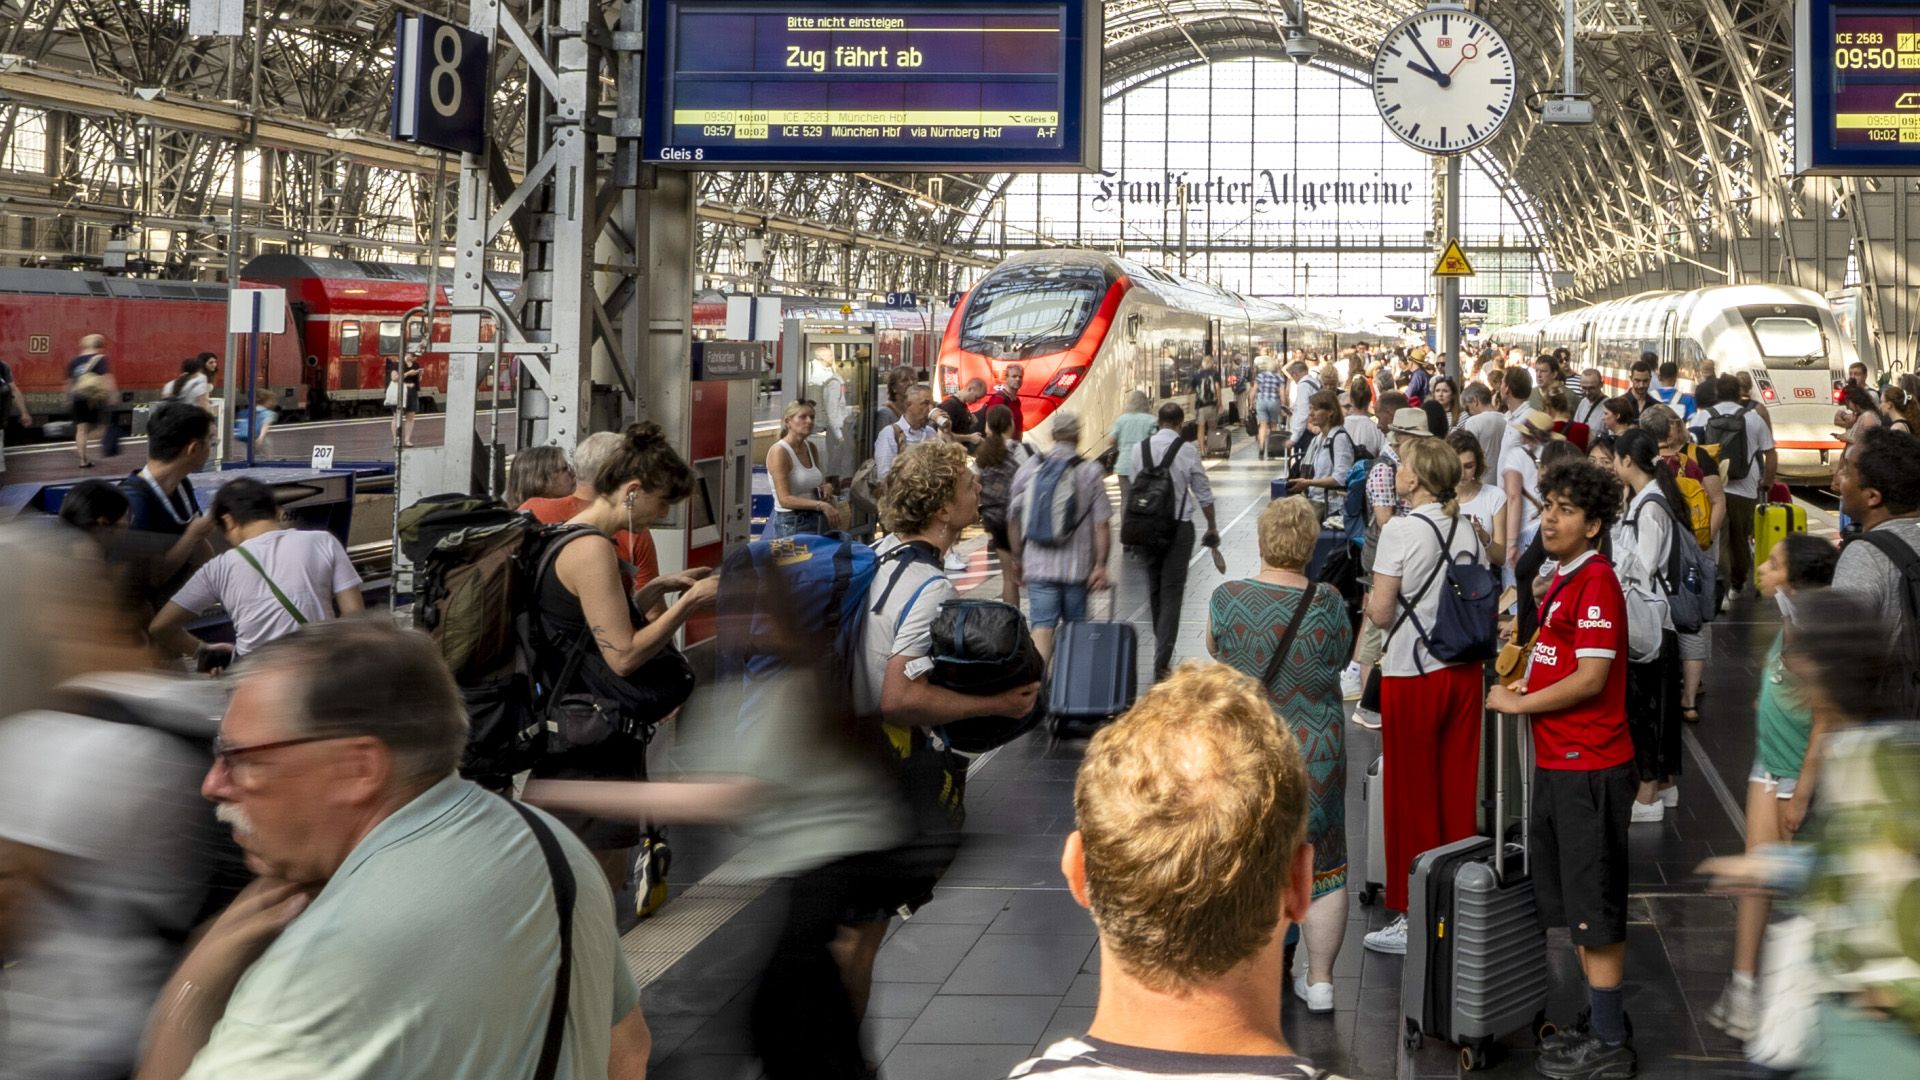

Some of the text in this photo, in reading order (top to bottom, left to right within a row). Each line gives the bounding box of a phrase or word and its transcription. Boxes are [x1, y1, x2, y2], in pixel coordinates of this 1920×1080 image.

[787, 16, 904, 29] Bitte nicht einsteigen
[1439, 39, 1450, 47] DB
[1836, 33, 1883, 44] ICE 2583
[786, 46, 923, 72] Zug fährt ab
[1835, 48, 1896, 69] 09:50
[430, 25, 462, 117] 8
[704, 112, 1056, 123] 09:50 10:00 ICE 2583 München Hbf Gleis 9
[1867, 115, 1897, 126] 09:50
[703, 126, 1056, 139] 09:57 10:02 ICE 529 München Hbf via Nürnberg Hbf A-F
[1867, 129, 1897, 140] 10:02
[660, 148, 704, 160] Gleis 8
[1091, 168, 1412, 213] Frankfurter Allgemeine
[887, 293, 912, 305] 6 A
[1395, 297, 1420, 309] 8 A
[1461, 300, 1487, 311] A 9
[31, 337, 48, 352] DB
[1796, 389, 1813, 398] DB
[314, 447, 333, 458] 207
[1578, 619, 1612, 629] Expedia
